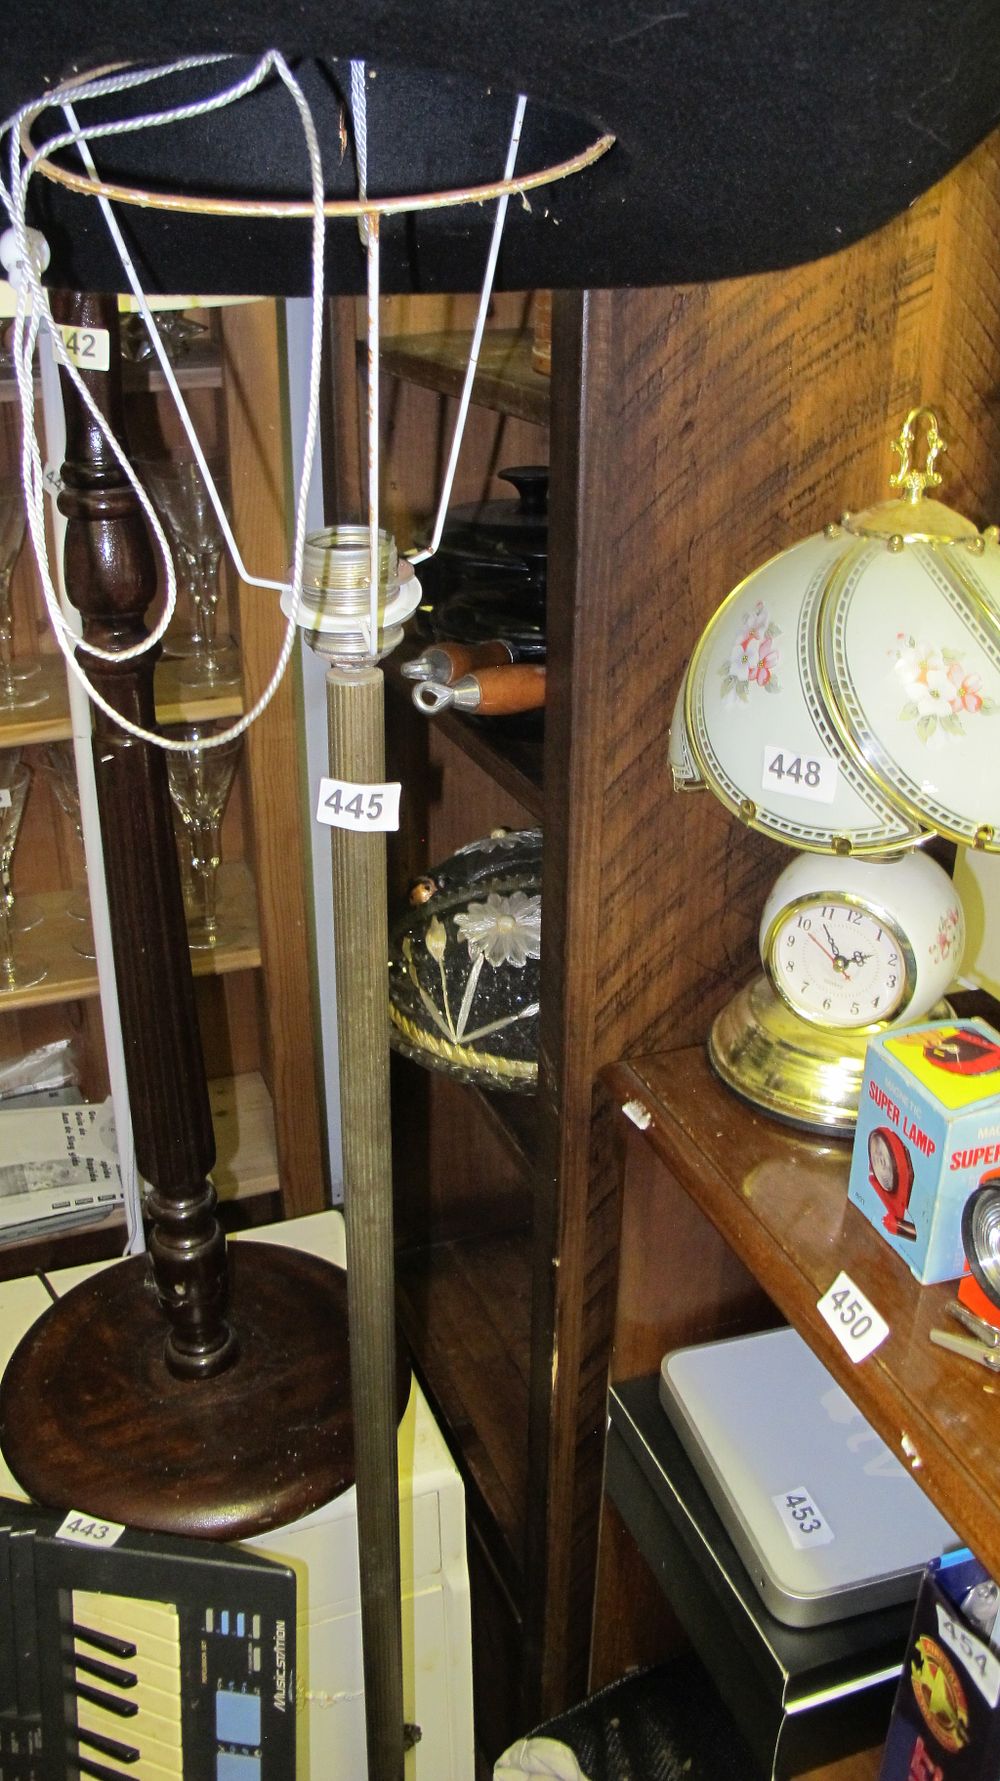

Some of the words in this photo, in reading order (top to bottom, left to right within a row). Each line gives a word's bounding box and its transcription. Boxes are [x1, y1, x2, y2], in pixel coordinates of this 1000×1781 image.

[768, 753, 821, 787] 448
[324, 789, 384, 820] 445
[821, 906, 835, 921] 11
[847, 909, 863, 925] 12
[797, 916, 812, 931] 10
[786, 935, 795, 947] 9
[875, 928, 883, 942] 1
[785, 960, 795, 973] 8
[887, 953, 898, 967] 2
[800, 981, 810, 994] 7
[886, 975, 897, 988] 3
[822, 999, 832, 1011] 6
[849, 1002, 860, 1015] 5
[871, 996, 880, 1008] 4
[868, 1080, 900, 1127] SUPER
[902, 1116, 936, 1157] LAMP
[831, 1289, 873, 1339] 450
[786, 1495, 822, 1534] 453
[64, 1517, 110, 1540] 443
[943, 1620, 987, 1678] 454
